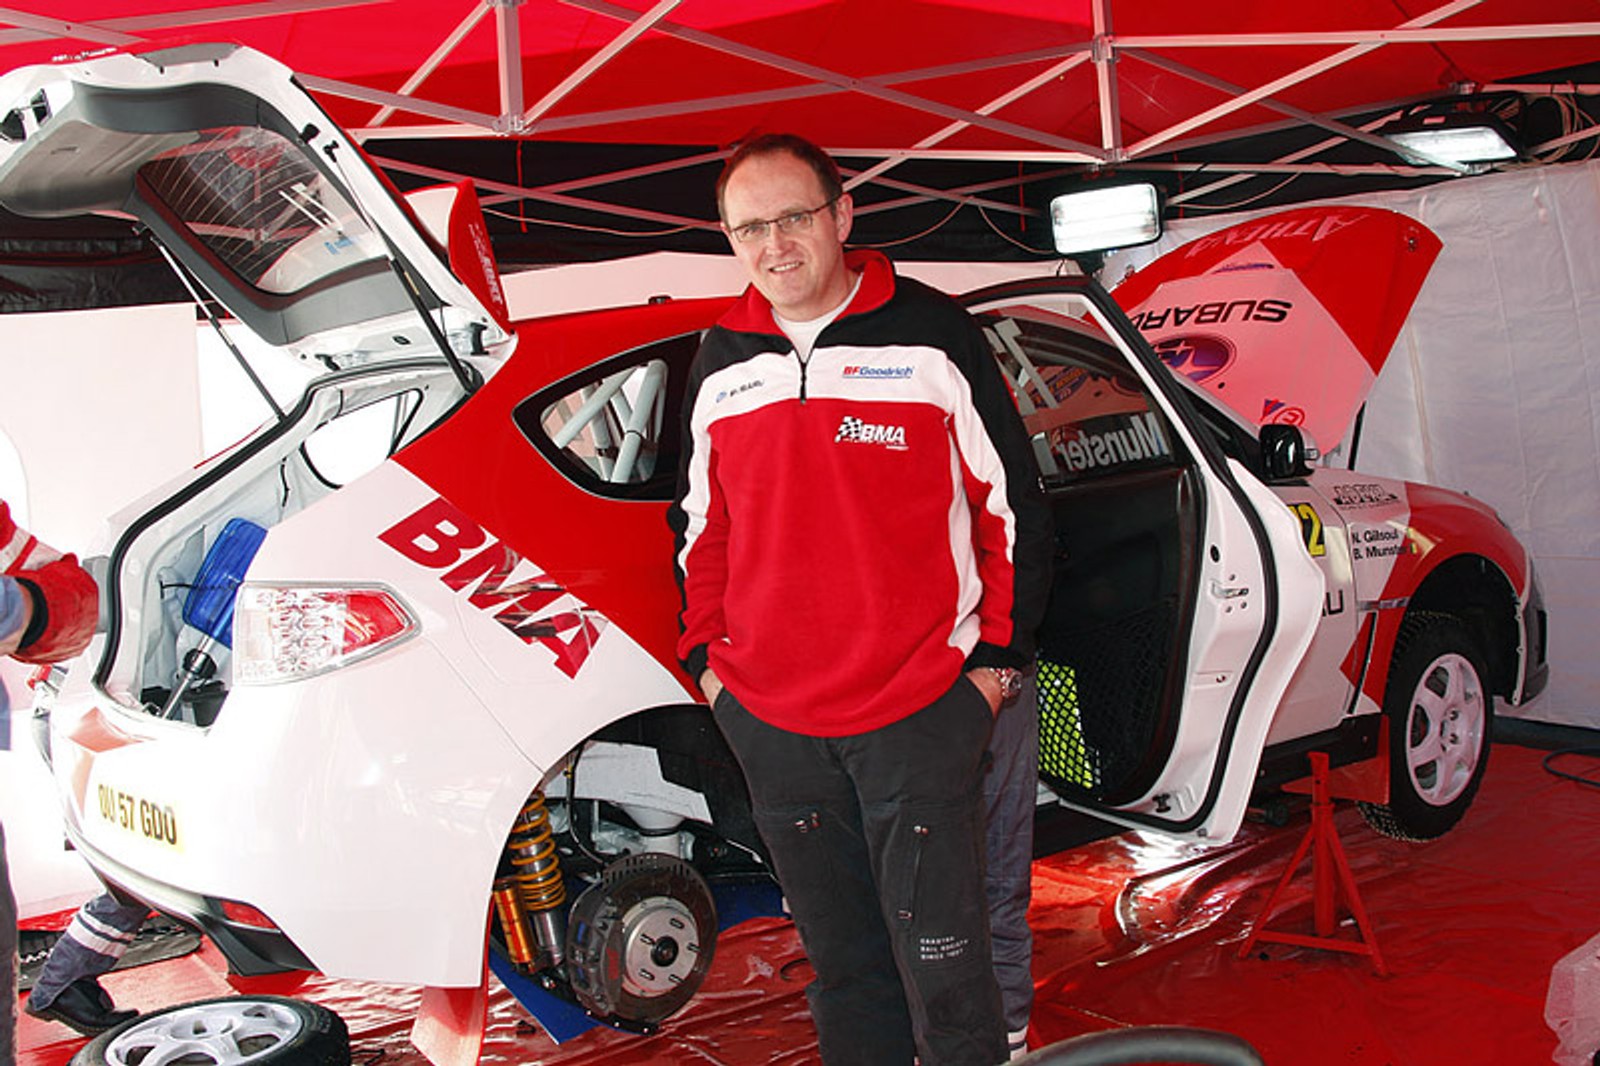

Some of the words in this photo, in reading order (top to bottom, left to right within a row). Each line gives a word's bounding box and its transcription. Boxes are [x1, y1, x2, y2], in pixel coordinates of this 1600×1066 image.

[843, 366, 914, 377] BFGoodrich
[860, 424, 906, 444] BMA
[1288, 503, 1326, 556] 2
[377, 496, 608, 680] BMA
[118, 792, 135, 831] 57
